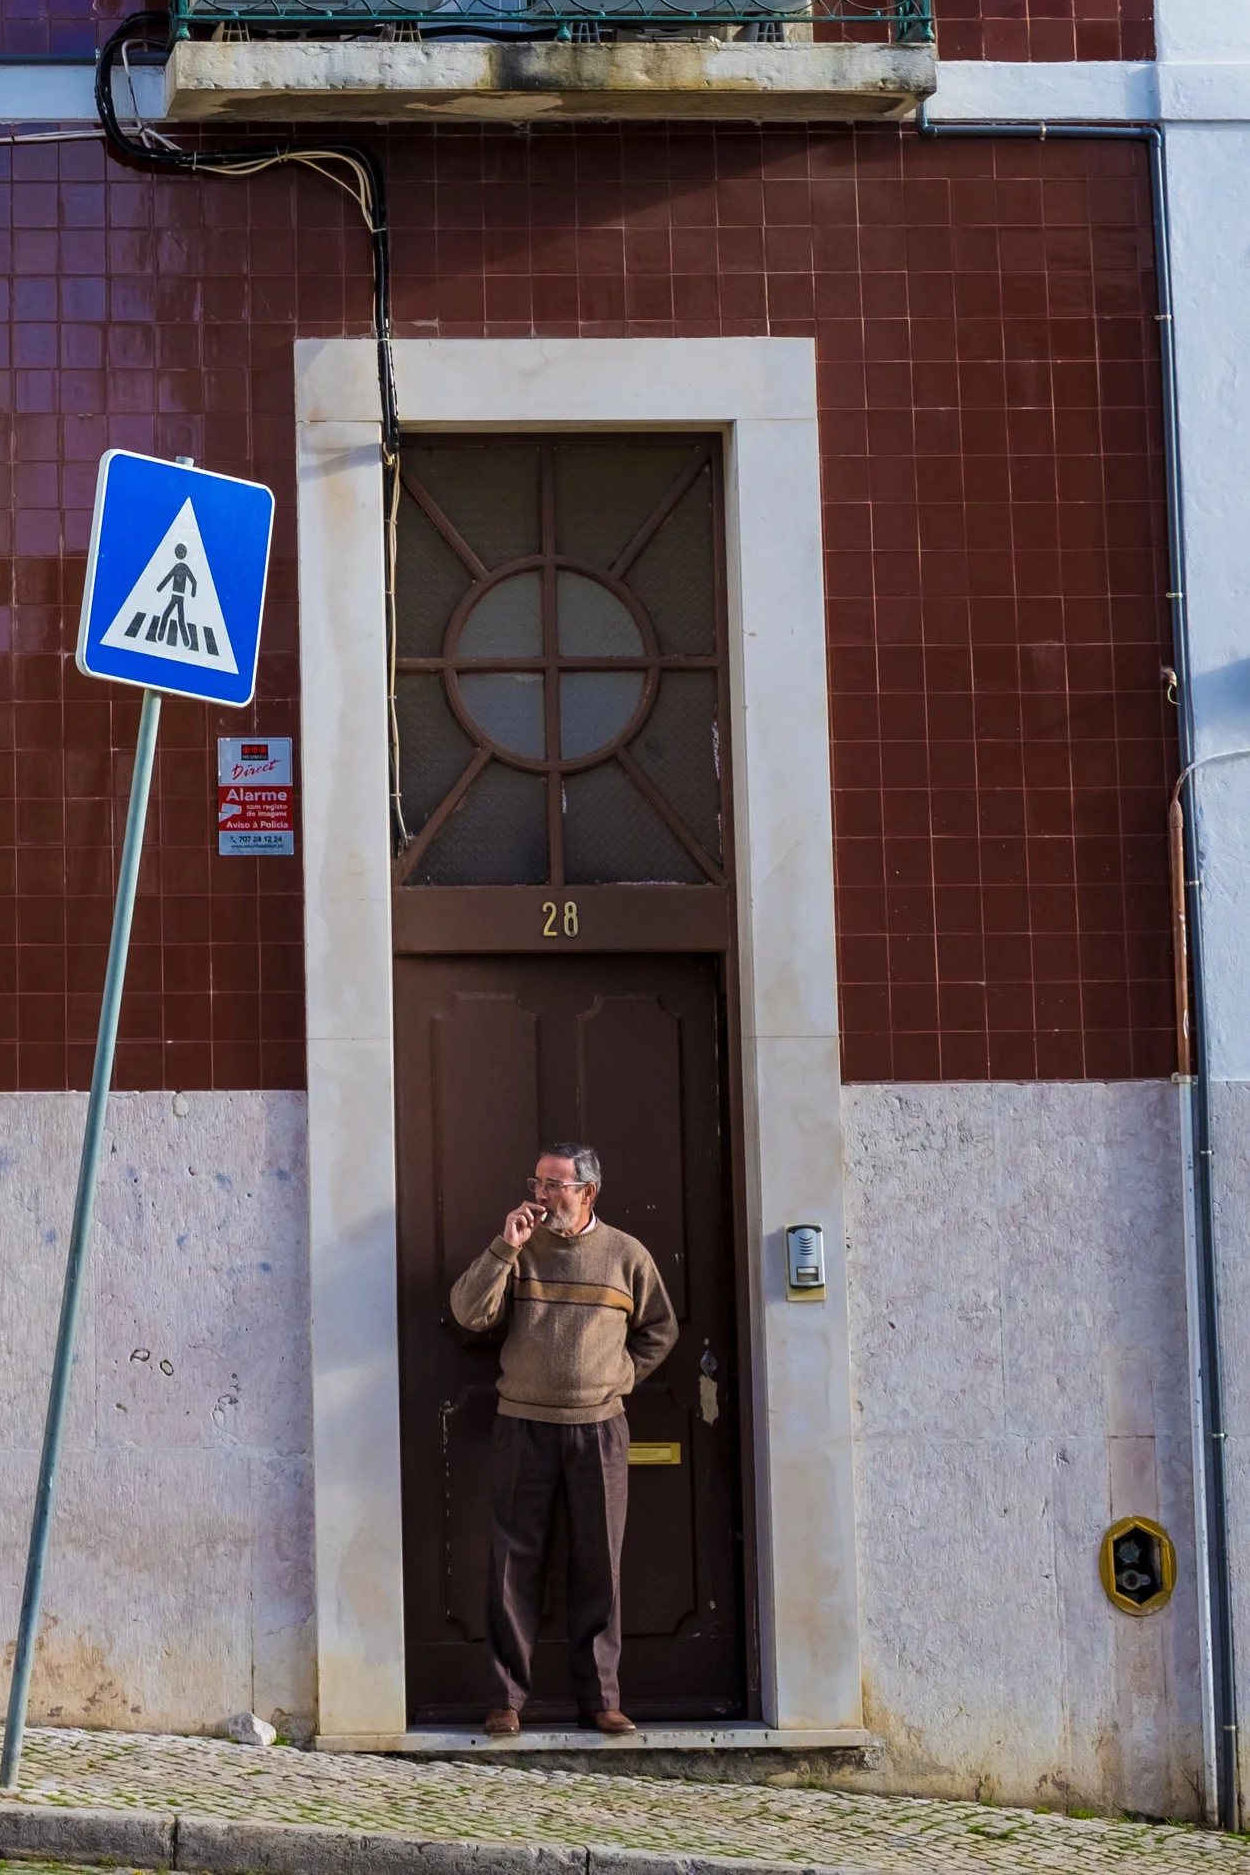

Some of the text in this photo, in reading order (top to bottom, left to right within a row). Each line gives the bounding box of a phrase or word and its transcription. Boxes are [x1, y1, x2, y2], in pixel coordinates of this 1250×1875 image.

[231, 759, 282, 781] Direct
[226, 787, 288, 801] Alarme
[263, 803, 288, 811] registo
[257, 810, 287, 818] imagens
[226, 820, 289, 829] Aviso à Polícia
[542, 901, 579, 937] 28
